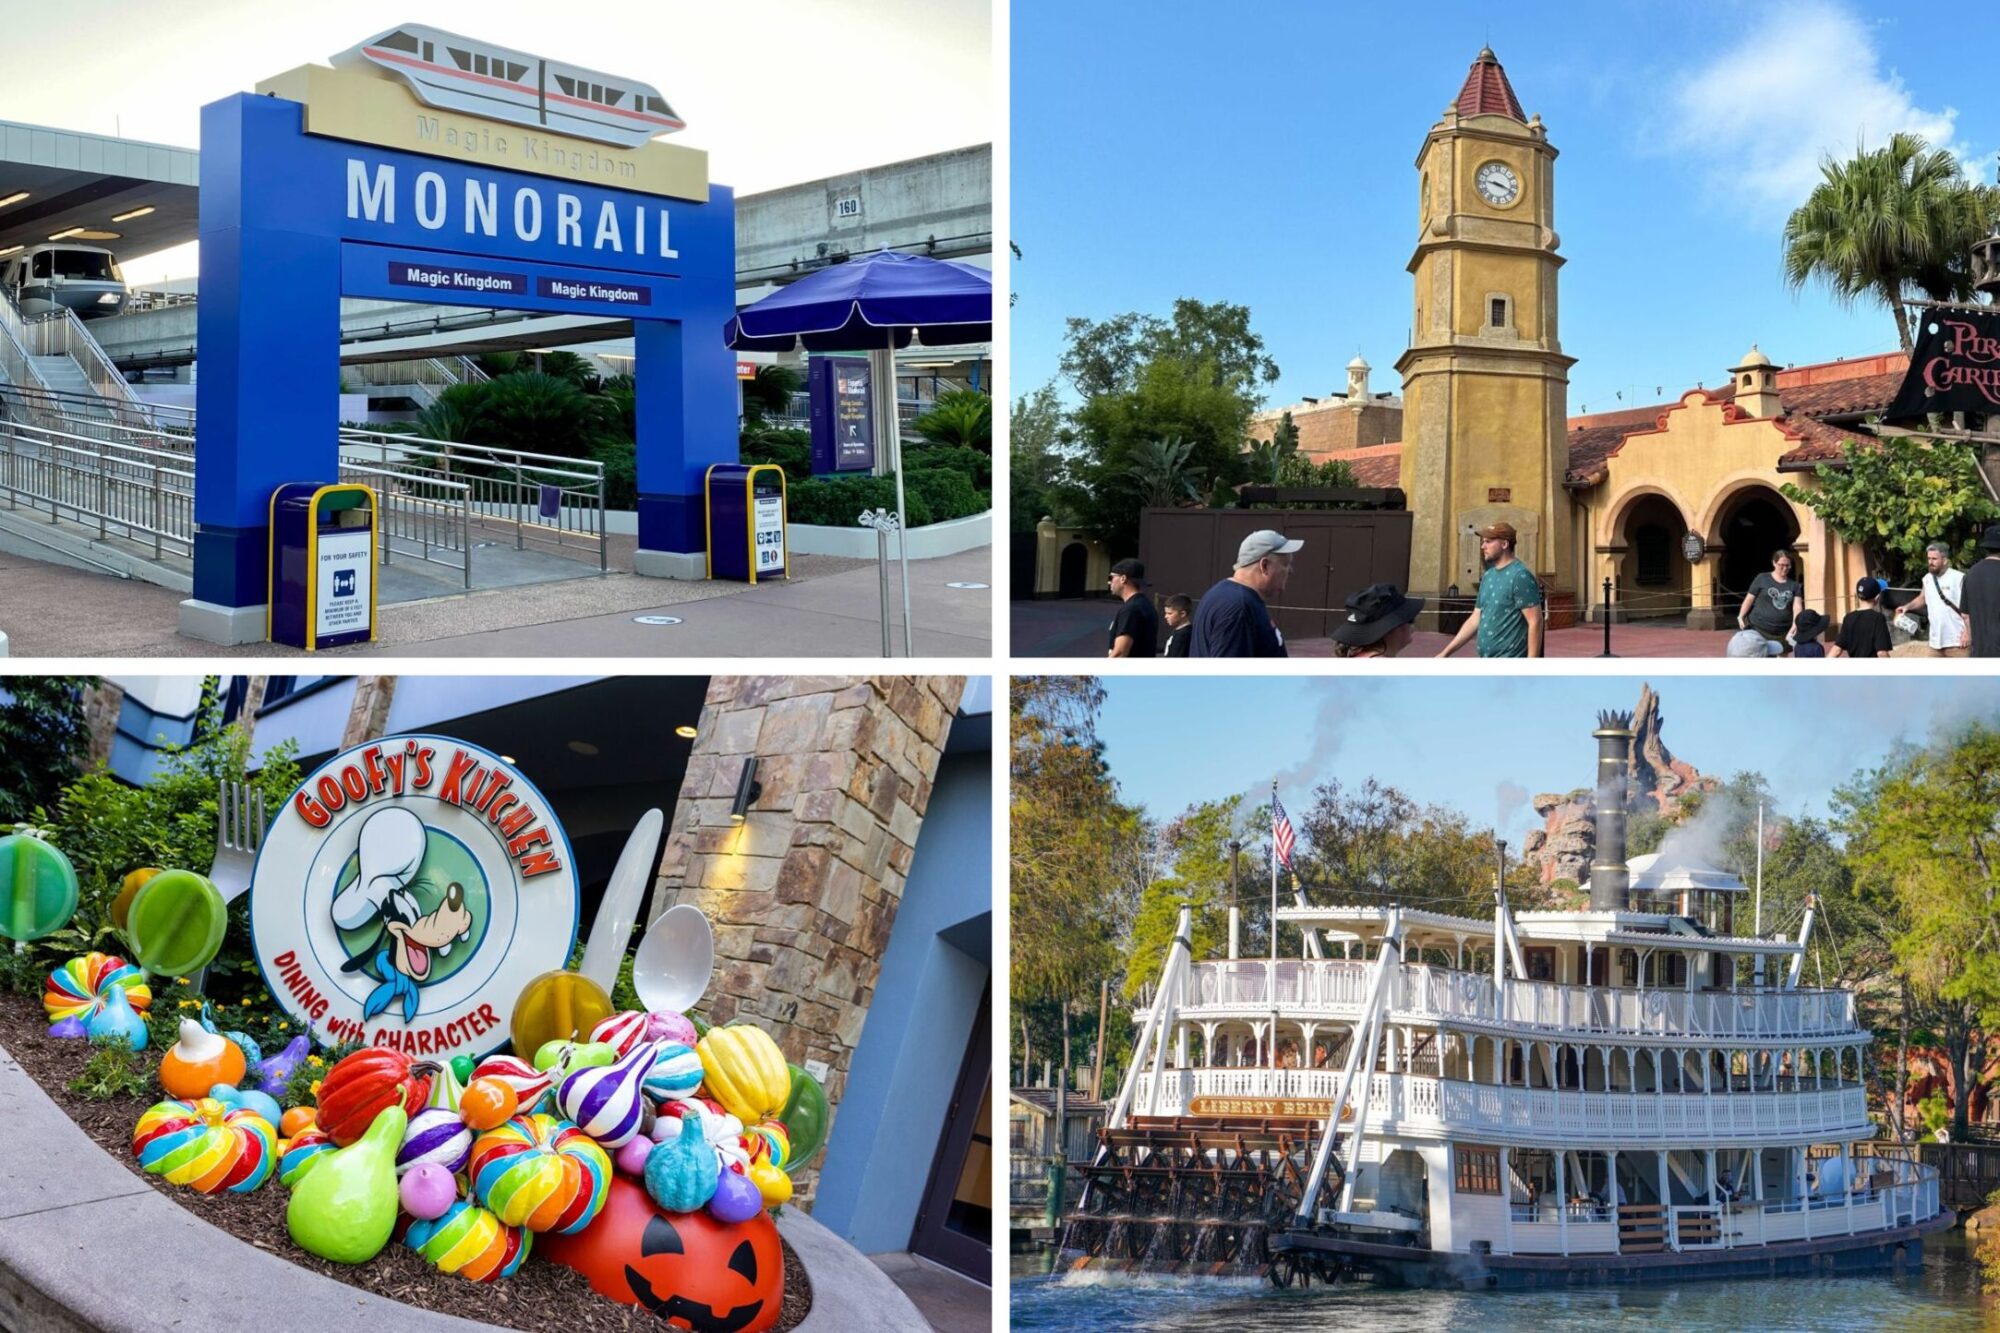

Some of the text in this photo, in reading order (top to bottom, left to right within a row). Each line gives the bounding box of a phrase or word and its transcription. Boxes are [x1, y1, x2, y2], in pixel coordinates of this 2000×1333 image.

[416, 115, 636, 178] Magic Kingdom
[347, 158, 679, 259] MONORAIL
[840, 199, 857, 215] 160
[407, 268, 513, 291] Magic Kingdom
[552, 281, 639, 301] Magic Kingdom
[333, 553, 347, 561] YOUR
[348, 551, 367, 559] SAFETY
[438, 748, 563, 878] KITCHEN
[273, 950, 501, 1056] DINING with CHARACTER
[1200, 1100, 1277, 1115] LIBERTY
